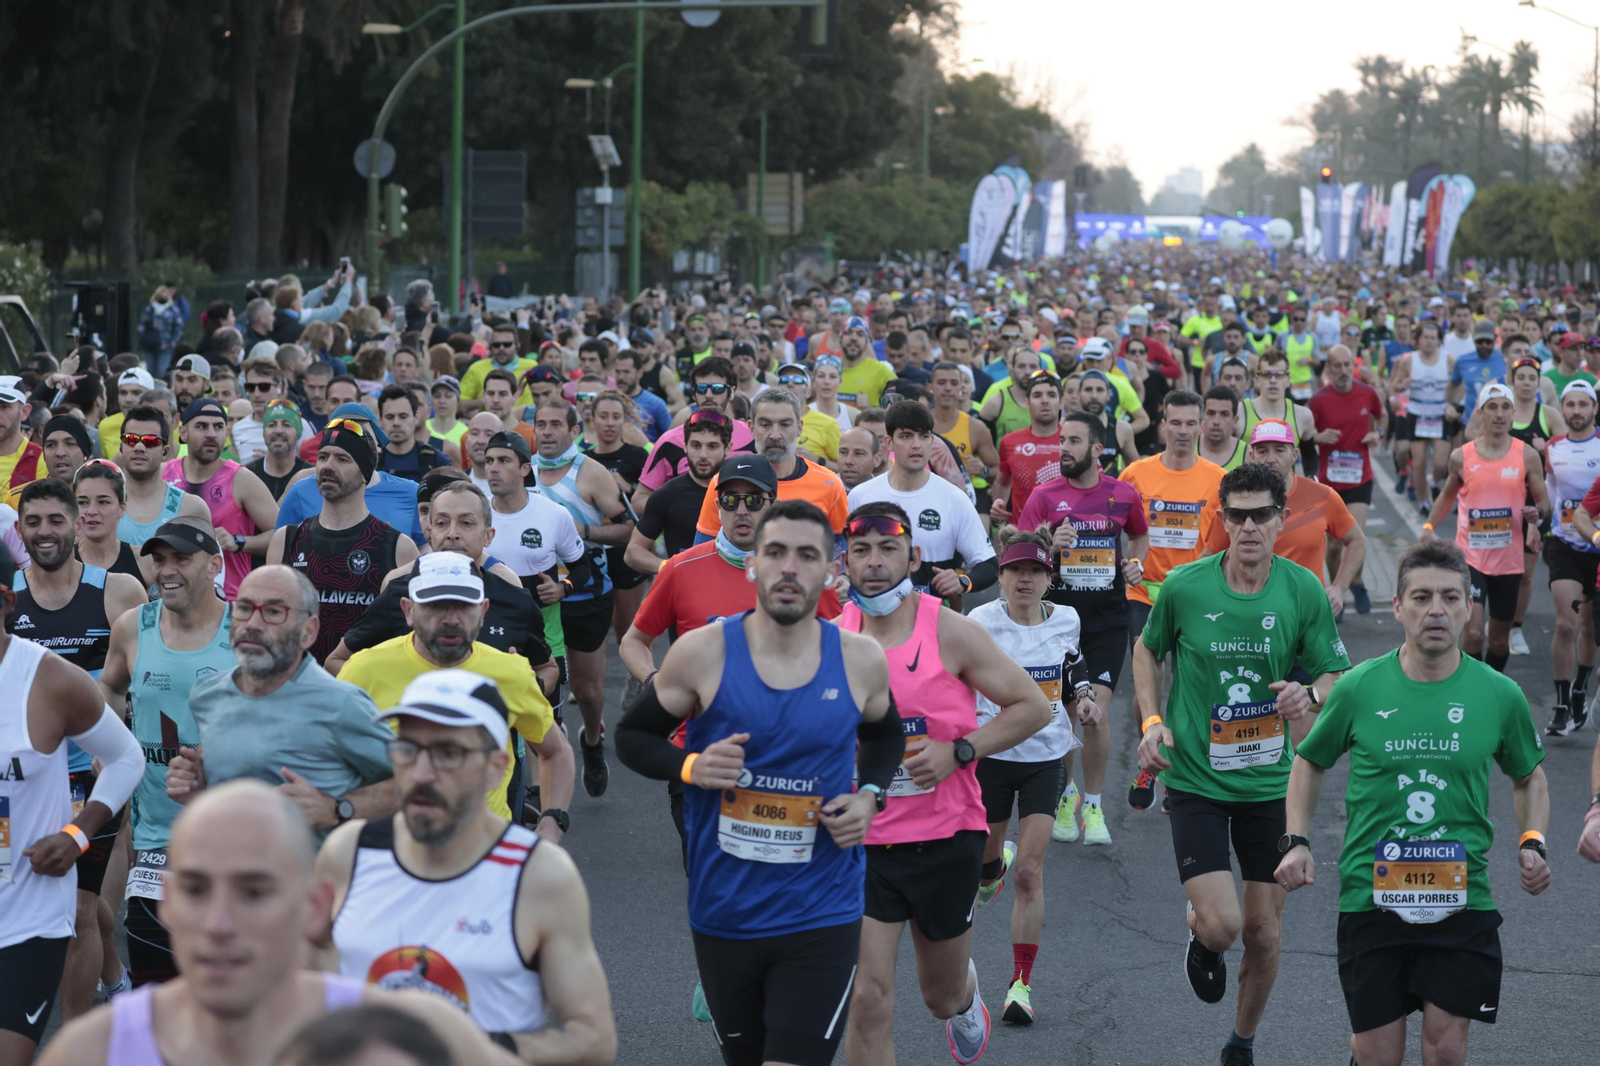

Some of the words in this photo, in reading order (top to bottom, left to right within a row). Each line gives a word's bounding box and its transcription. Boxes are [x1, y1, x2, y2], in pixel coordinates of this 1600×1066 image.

[1166, 503, 1196, 512] ZURICH
[1165, 518, 1182, 526] 5534
[1079, 539, 1109, 547] ZURICH
[1079, 555, 1098, 563] 4864
[1067, 567, 1092, 575] MANUEL
[1094, 567, 1109, 575] POZO
[1210, 642, 1271, 653] SUNCLUB
[1029, 669, 1056, 679] URICH
[1220, 671, 1234, 684] A
[1237, 666, 1261, 683] les
[1228, 683, 1252, 705] 8
[1234, 702, 1276, 717] ZURICH
[1235, 727, 1260, 739] 4191
[1236, 743, 1260, 753] JUAKI
[1385, 739, 1460, 752] SUNCLUB
[0, 757, 25, 781] A
[754, 775, 814, 792] ZURICH
[1397, 774, 1414, 790] A
[1418, 769, 1447, 790] les
[752, 804, 787, 820] 4086
[1406, 791, 1435, 824] 8
[731, 822, 771, 839] HIGINIO
[775, 830, 803, 841] REUS
[140, 852, 167, 866] 2429
[1403, 847, 1455, 858] ZURICH
[1404, 872, 1435, 885] 4112
[1382, 891, 1415, 904] ÒSCAR
[1418, 894, 1459, 904] PORRES
